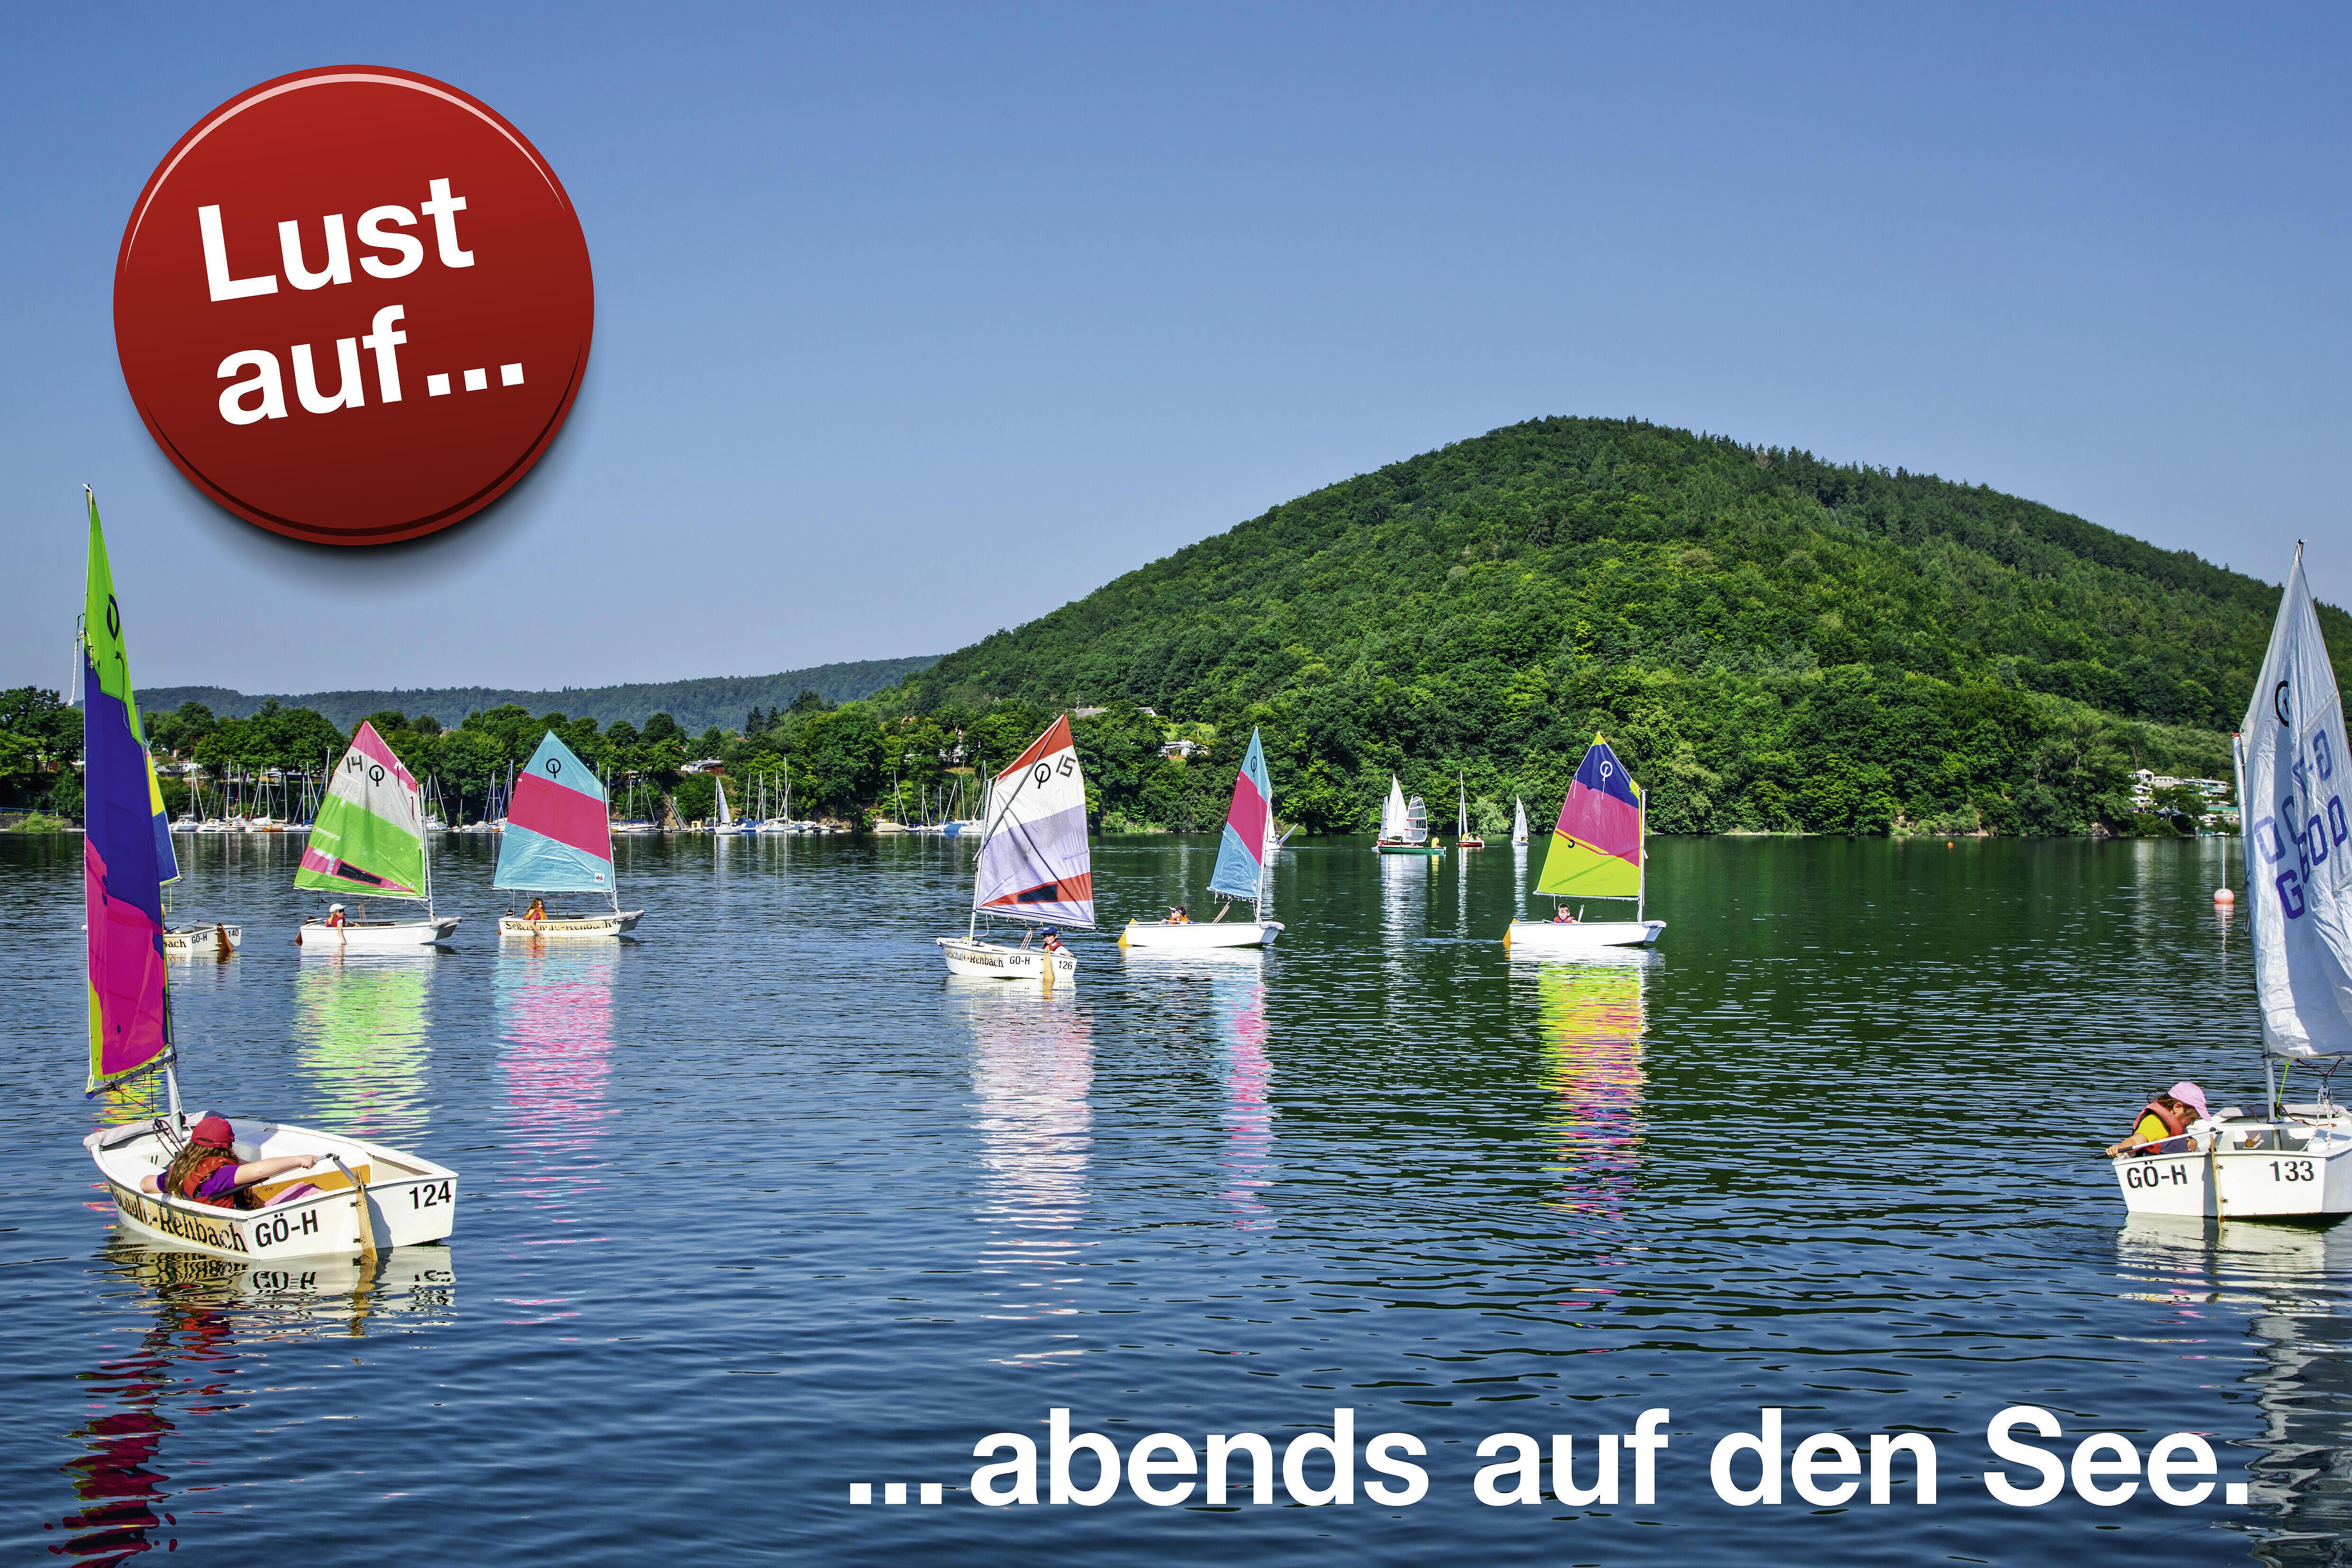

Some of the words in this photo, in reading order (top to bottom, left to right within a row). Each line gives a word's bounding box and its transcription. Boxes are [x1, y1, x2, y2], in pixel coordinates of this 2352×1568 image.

[347, 755, 363, 773] 14
[1056, 755, 1076, 778] 15
[228, 929, 239, 937] 140
[1059, 960, 1073, 970] 126
[2127, 1161, 2188, 1189] GÖ-H
[2270, 1160, 2315, 1182] 133
[409, 1180, 451, 1210] 124
[256, 1209, 318, 1247] GÖ-H
